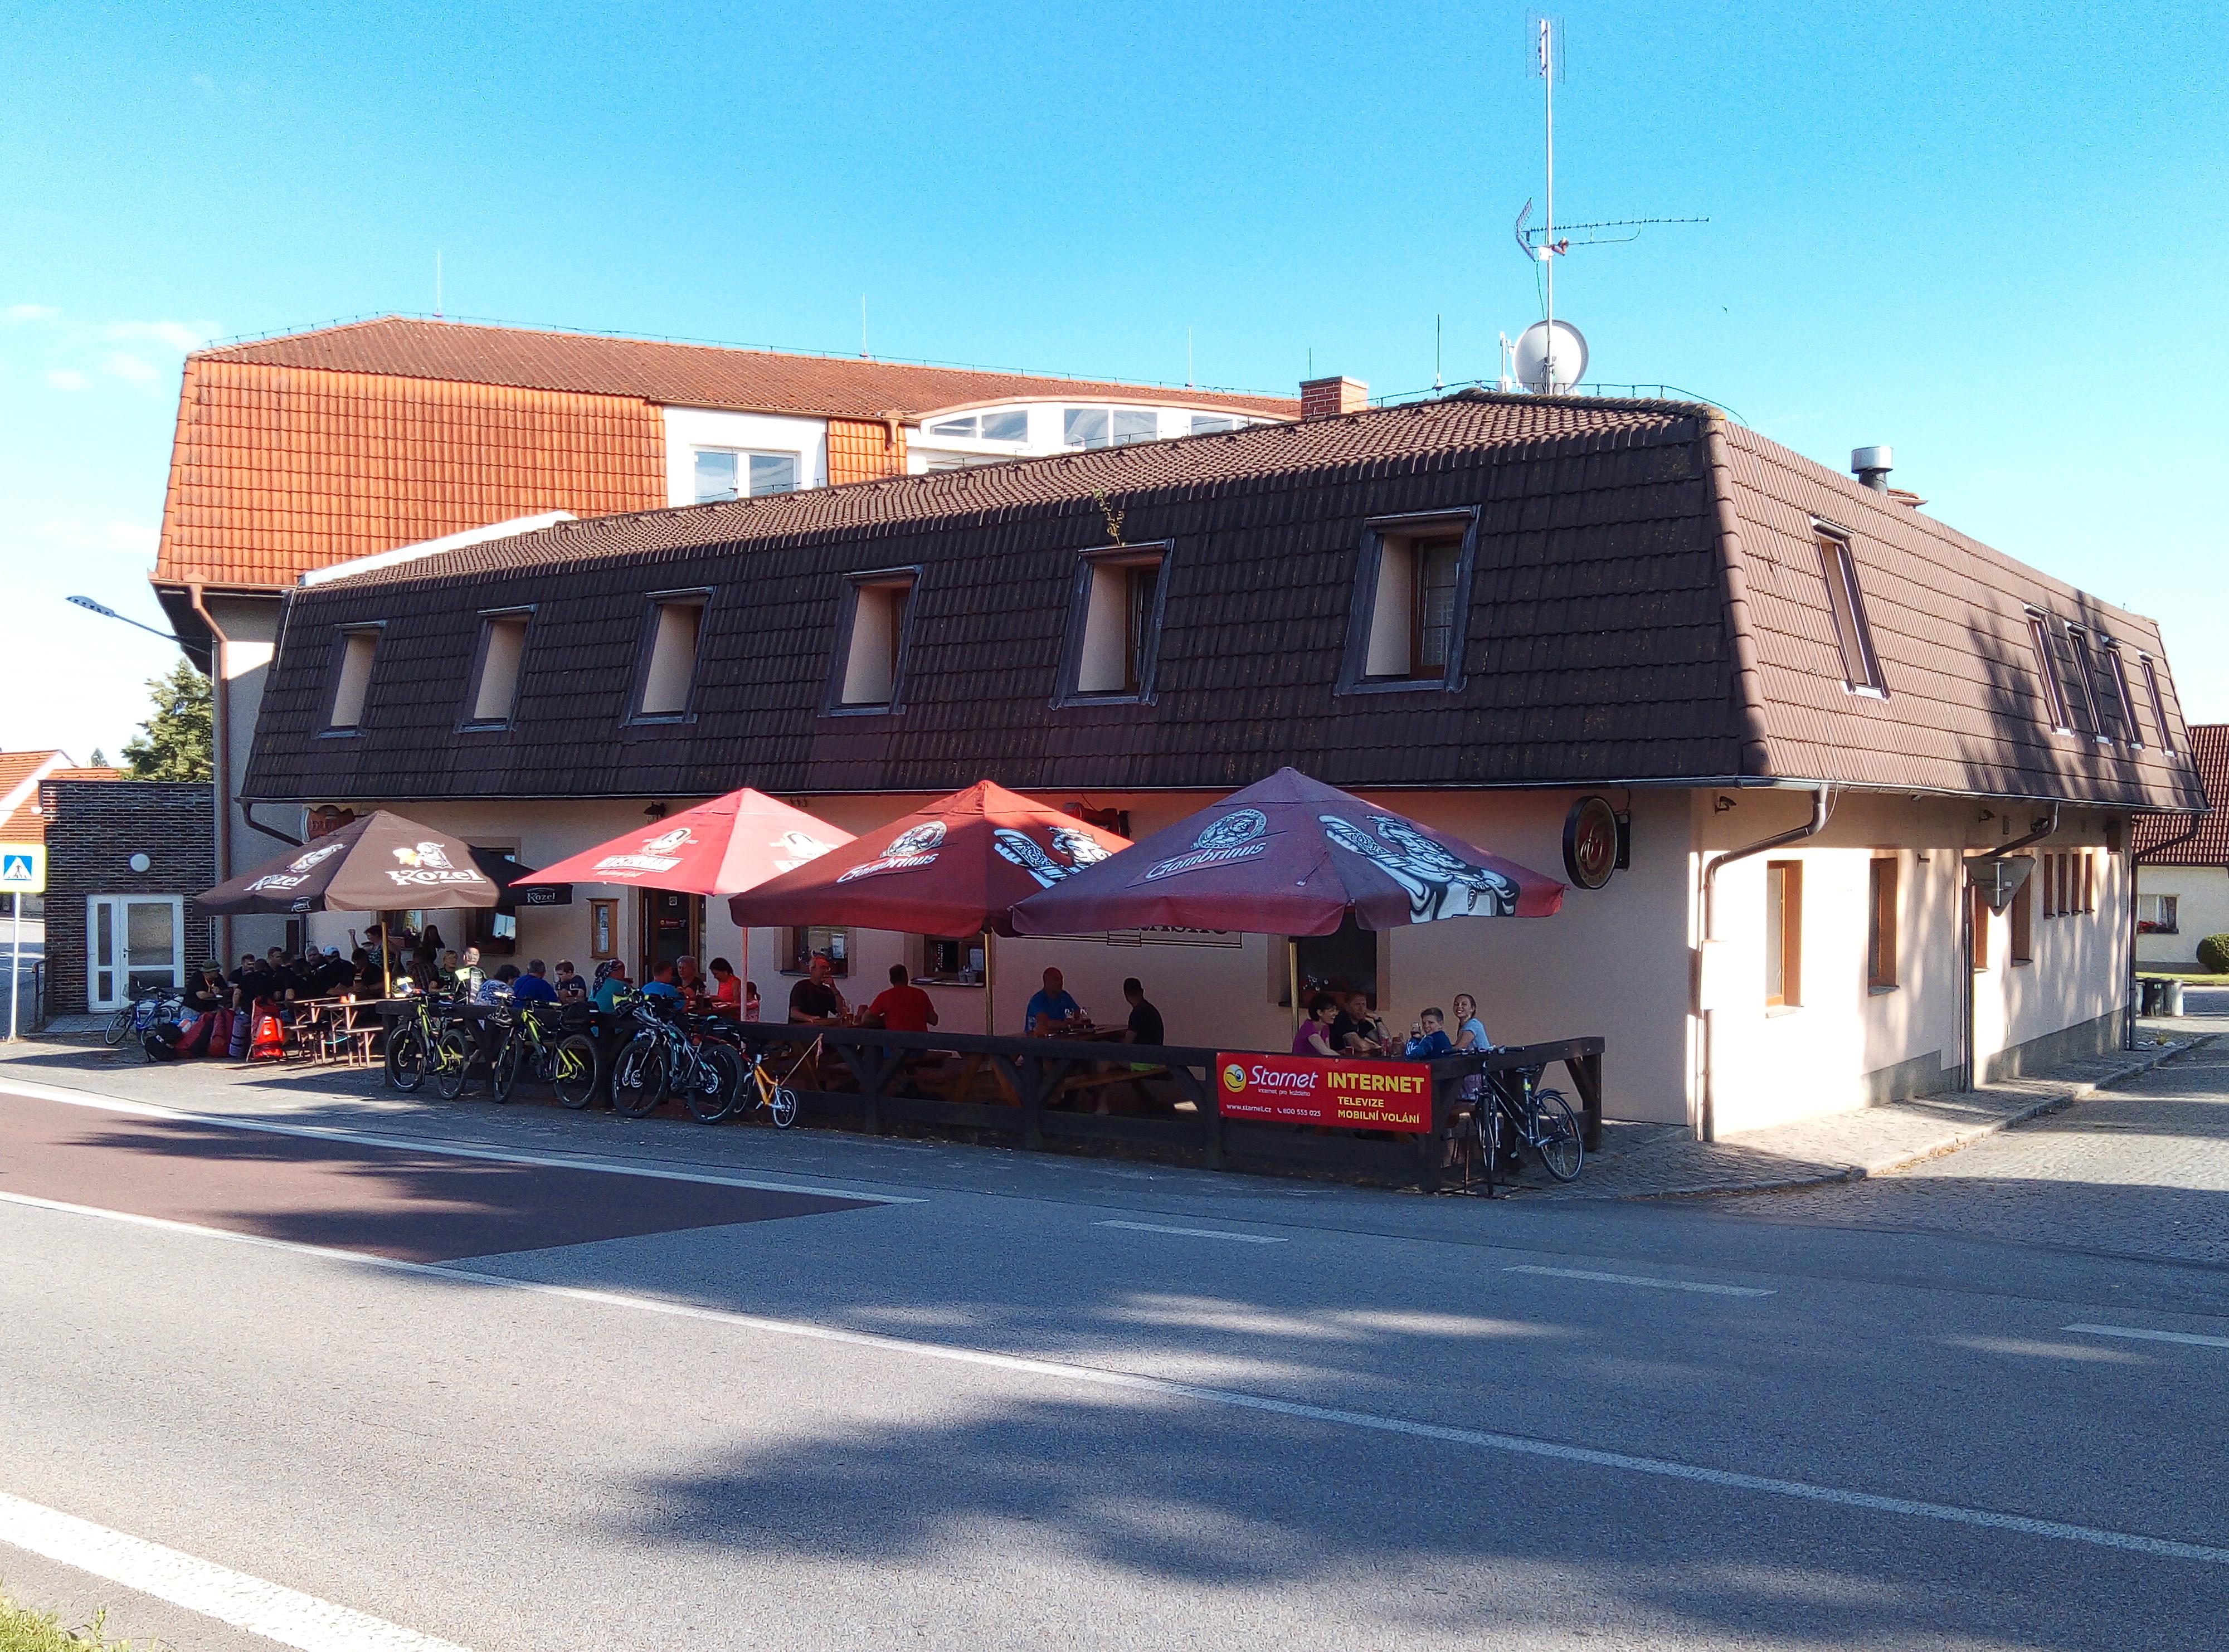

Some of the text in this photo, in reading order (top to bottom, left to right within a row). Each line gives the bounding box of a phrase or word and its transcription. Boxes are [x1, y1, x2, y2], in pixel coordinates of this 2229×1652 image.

[836, 854, 940, 883] Gambrinus
[1146, 843, 1266, 879] Gambrinus
[386, 869, 487, 886] Kozel
[527, 893, 556, 903] Kozel
[1249, 1065, 1318, 1089] Starnet
[1327, 1071, 1424, 1094] INTERNET
[1226, 1104, 1272, 1113] www.starnet.cz
[1337, 1096, 1384, 1107] TELEVIZE
[1338, 1109, 1420, 1124] MOBILNÍ VOLÁNÍ
